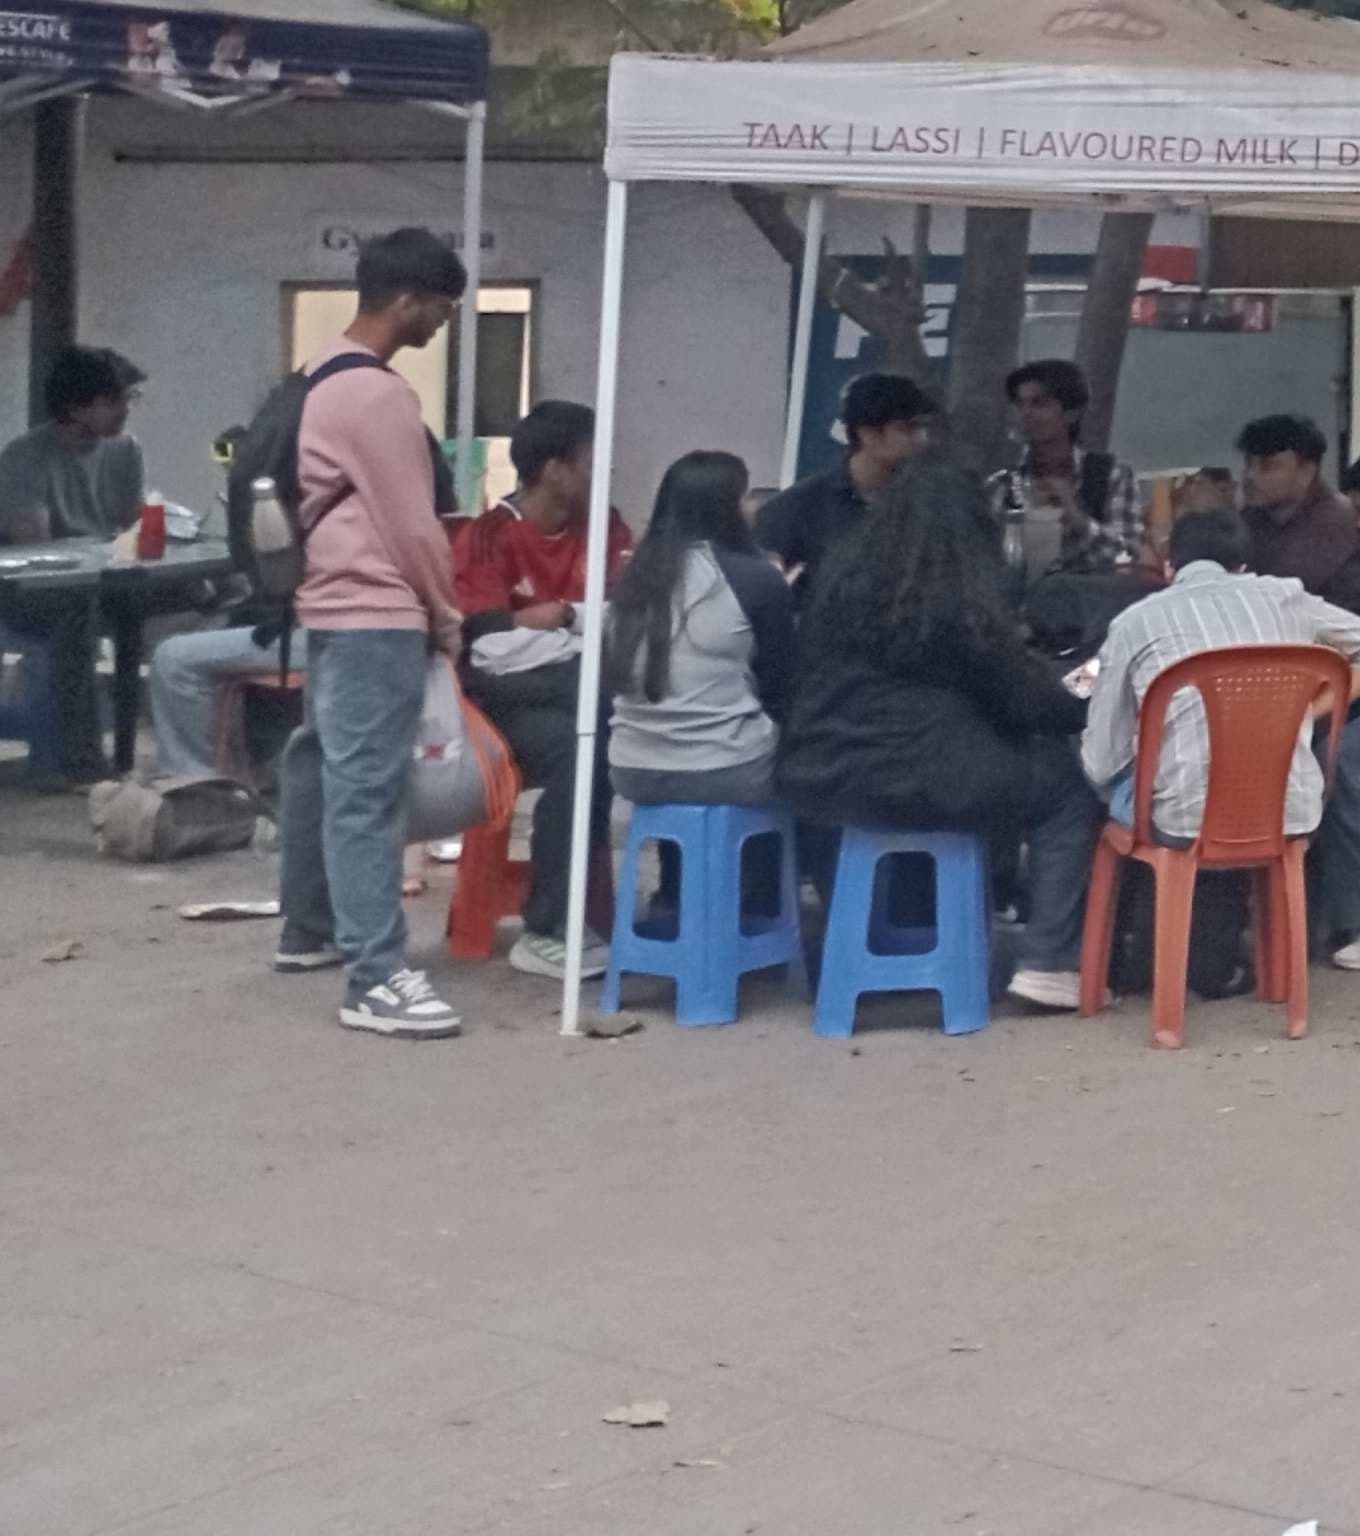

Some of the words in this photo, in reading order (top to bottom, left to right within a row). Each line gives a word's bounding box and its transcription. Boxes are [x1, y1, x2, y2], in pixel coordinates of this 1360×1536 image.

[743, 121, 831, 150] TAAK
[871, 126, 961, 154] LASSI
[1000, 128, 1203, 163] FLAVOURED
[1215, 137, 1299, 164] MILK
